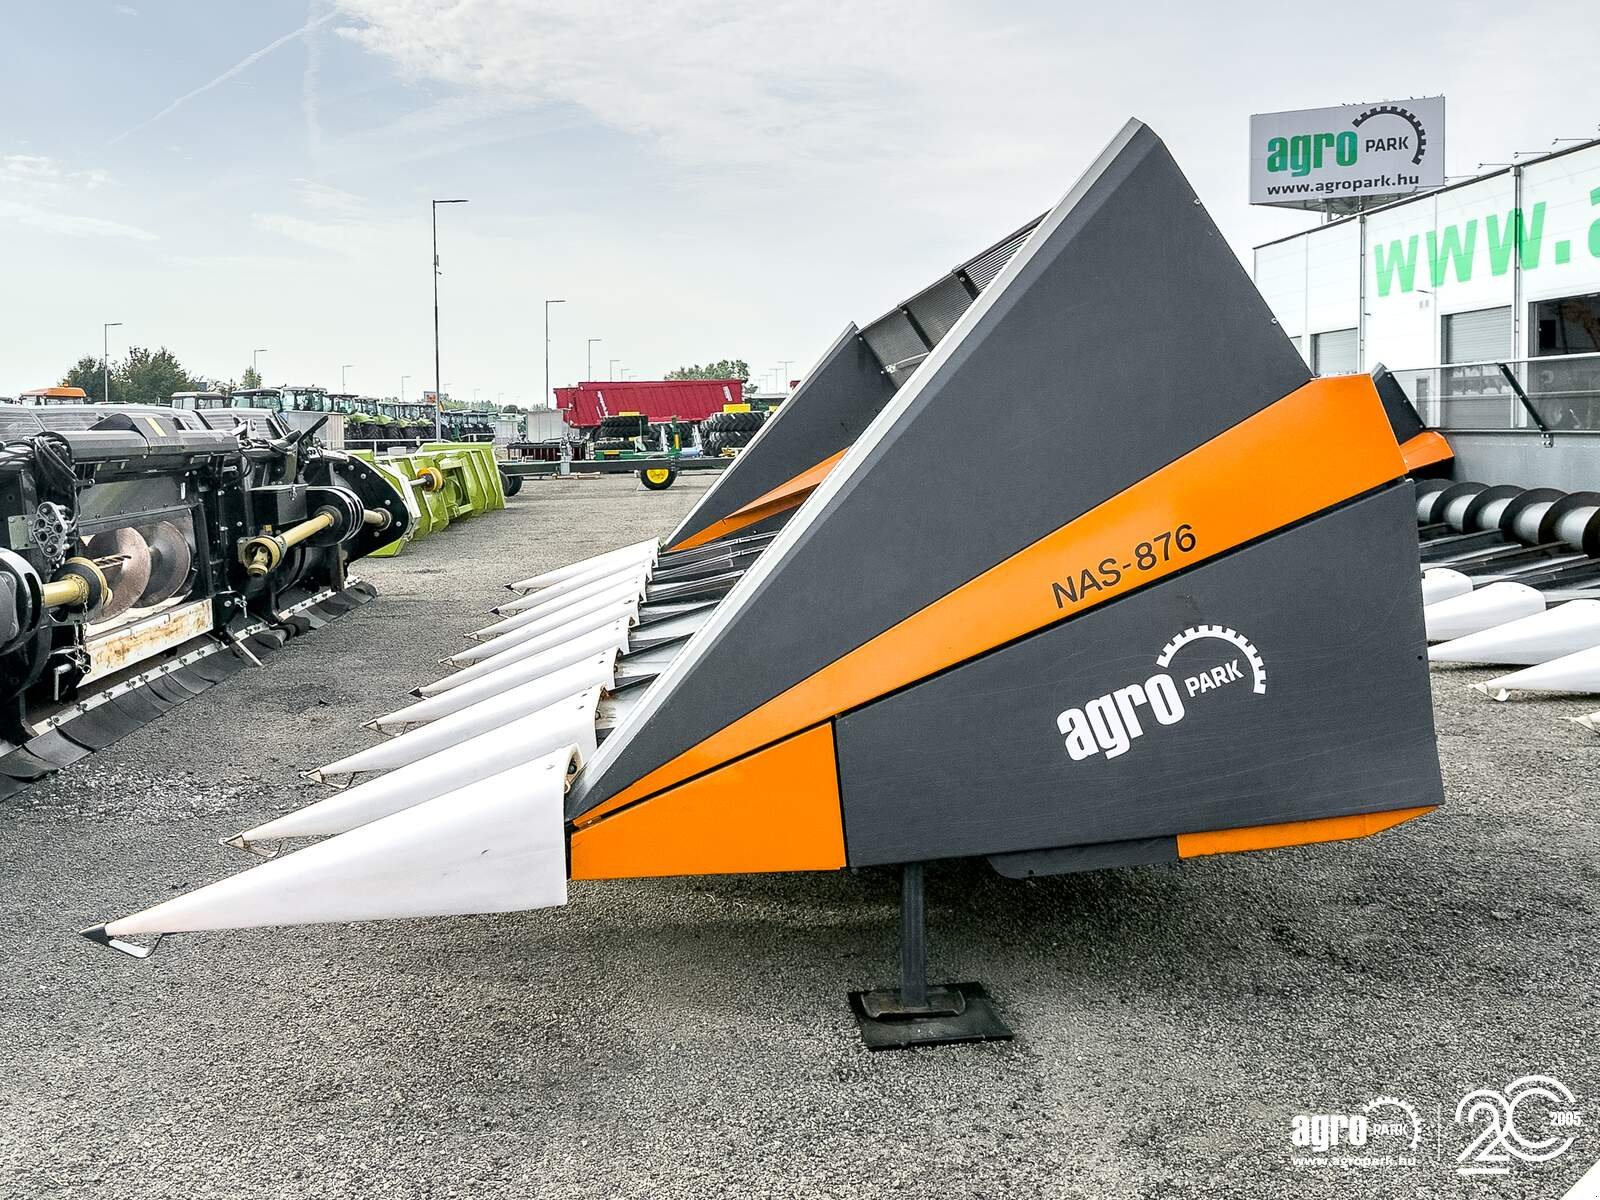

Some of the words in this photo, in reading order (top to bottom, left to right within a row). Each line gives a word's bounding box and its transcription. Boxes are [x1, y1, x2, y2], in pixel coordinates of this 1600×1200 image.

[1267, 131, 1358, 177] agro
[1365, 136, 1409, 153] PARK
[1267, 174, 1420, 195] www.agropark.hu
[1052, 524, 1197, 609] NAS-876
[1056, 673, 1186, 761] agro
[1184, 659, 1244, 698] PARK
